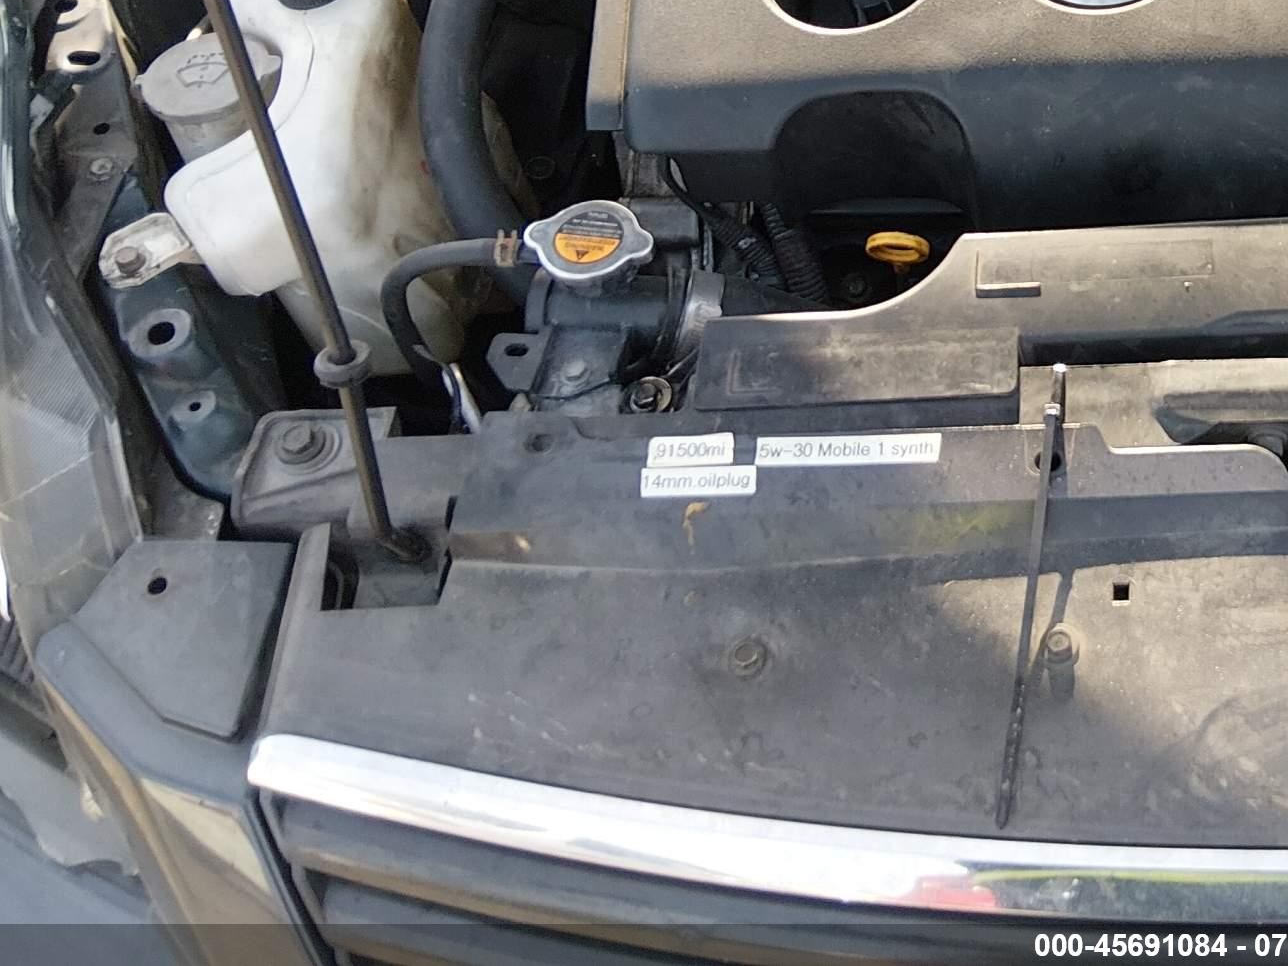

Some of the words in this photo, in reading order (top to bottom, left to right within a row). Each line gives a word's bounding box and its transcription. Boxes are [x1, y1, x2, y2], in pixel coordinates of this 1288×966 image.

[656, 441, 727, 458] 91500mi
[759, 441, 813, 459] 5w-30
[818, 440, 871, 458] Mobile
[878, 441, 885, 457] 1
[891, 440, 934, 460] synth
[643, 474, 692, 489] 14mm
[698, 472, 751, 490] oilplug
